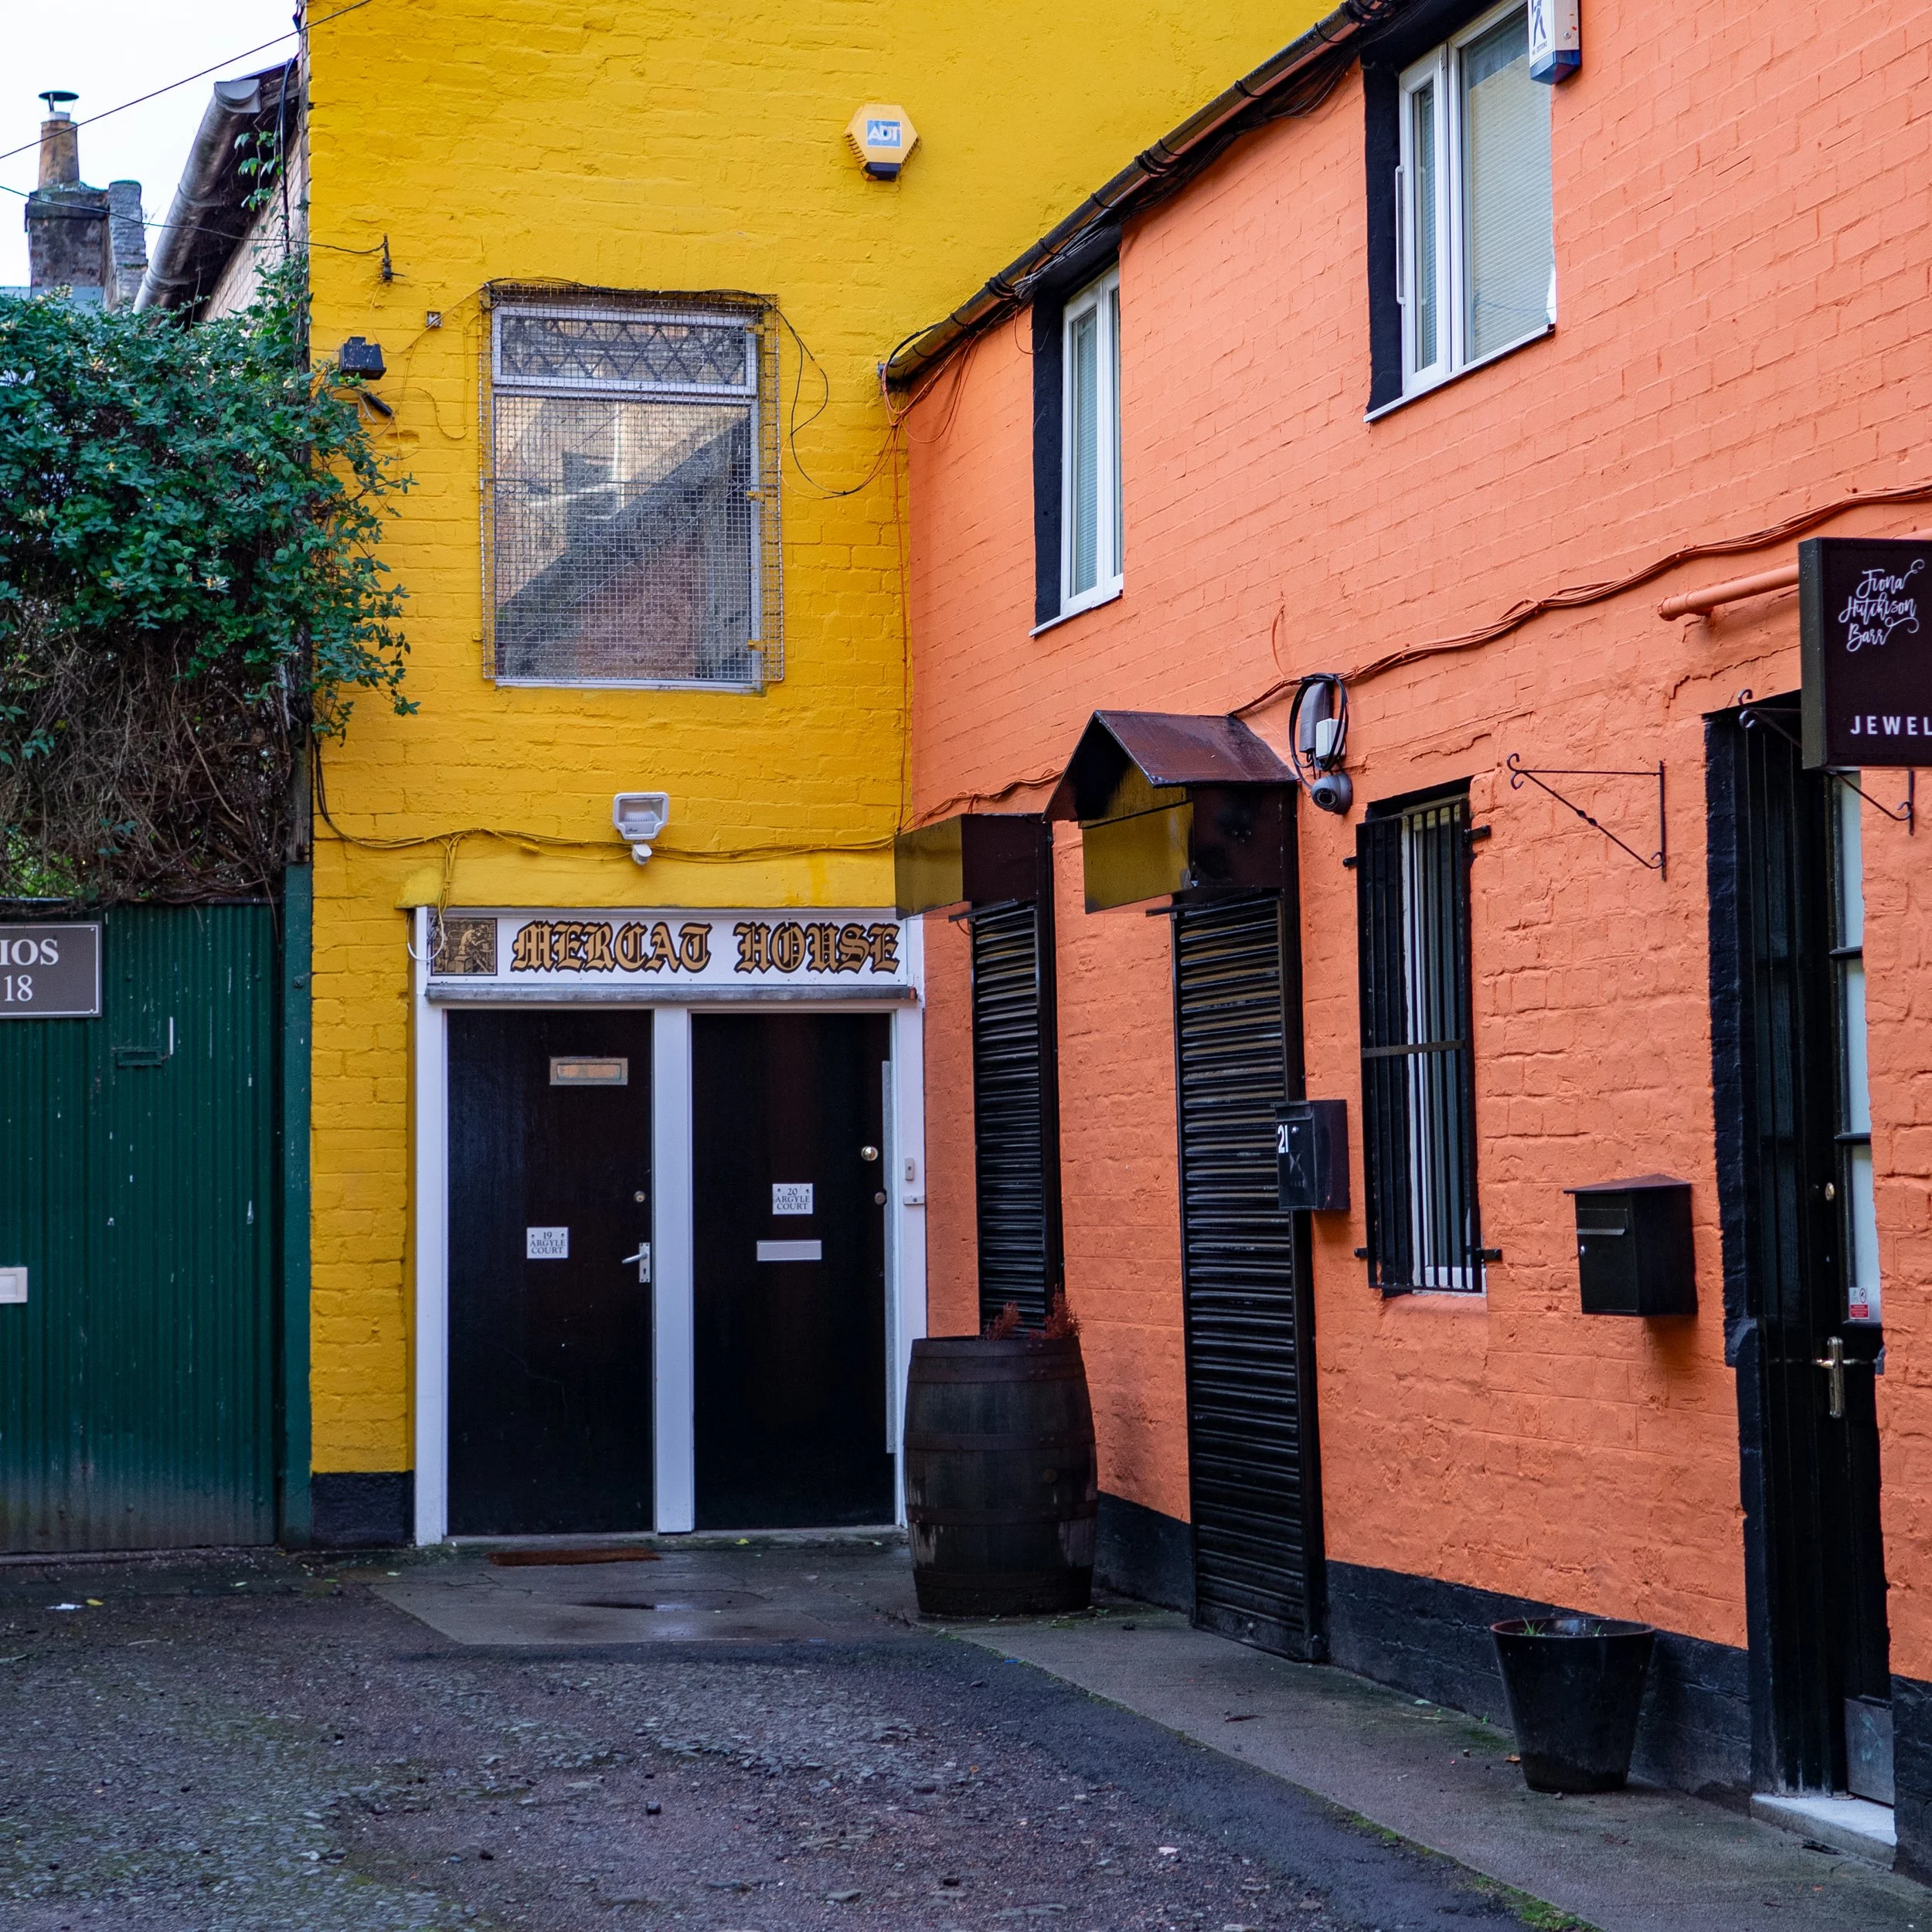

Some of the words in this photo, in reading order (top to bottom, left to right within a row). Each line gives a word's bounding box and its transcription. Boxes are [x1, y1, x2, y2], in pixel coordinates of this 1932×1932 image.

[868, 124, 900, 141] ADT
[1855, 559, 1925, 599] Fiona
[1846, 617, 1920, 652] Barr
[1850, 716, 1932, 736] JEWEL
[510, 920, 713, 974] MERCAT
[733, 921, 900, 975] HOUSE
[4, 974, 33, 1002] 18
[1277, 1124, 1288, 1154] 21
[543, 1231, 553, 1240] 19
